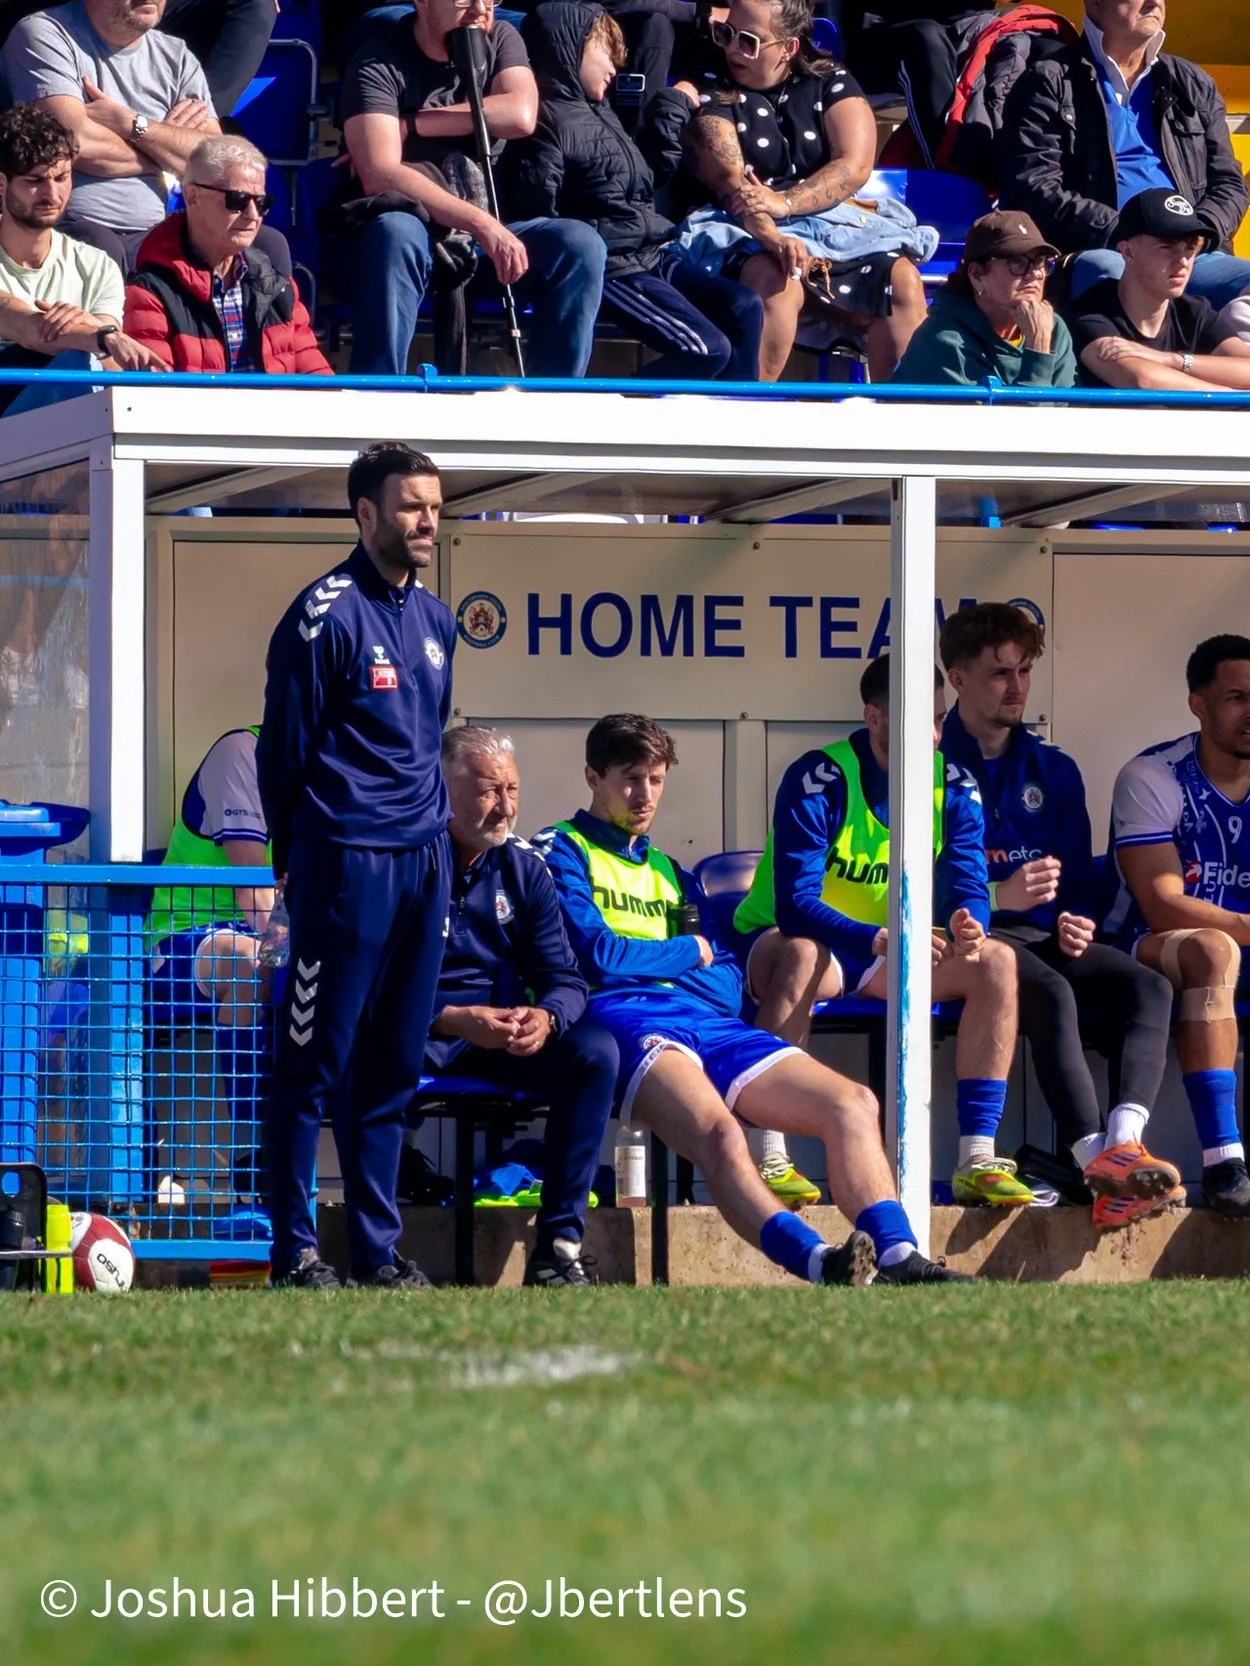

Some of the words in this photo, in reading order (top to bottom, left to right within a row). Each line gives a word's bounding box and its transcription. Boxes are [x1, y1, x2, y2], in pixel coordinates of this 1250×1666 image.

[527, 592, 745, 658] HOME
[1228, 816, 1243, 844] 9
[824, 847, 889, 884] hum
[590, 876, 677, 918] humm
